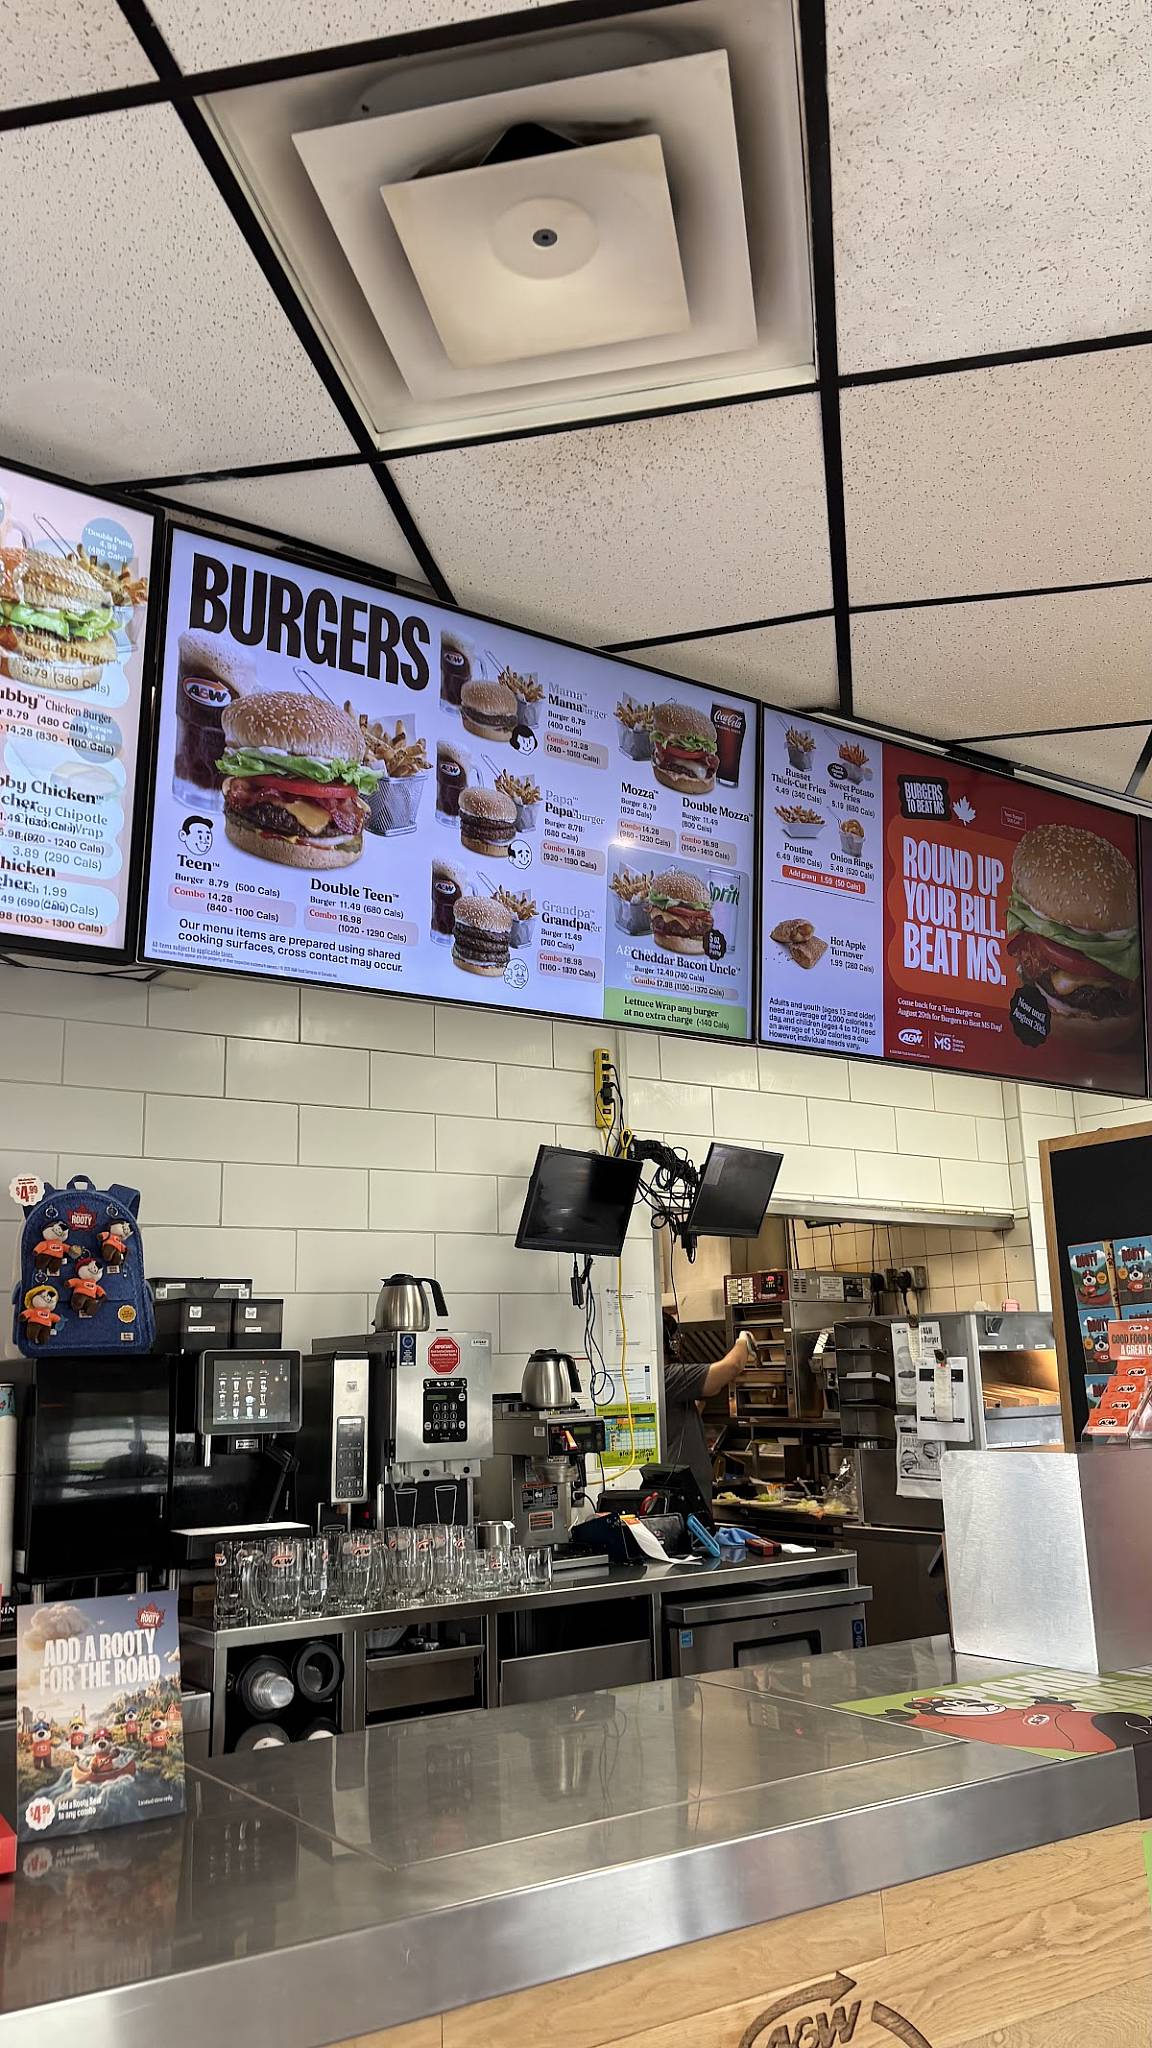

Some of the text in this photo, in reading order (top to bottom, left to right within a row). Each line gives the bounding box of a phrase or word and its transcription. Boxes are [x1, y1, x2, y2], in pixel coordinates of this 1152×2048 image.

[189, 552, 431, 692] BURGERS
[22, 665, 79, 687] 3.79 (360
[188, 685, 228, 703] A&W
[45, 699, 112, 724] Chicken Burger
[6, 708, 29, 721] 8.79
[37, 715, 59, 727] (480
[62, 721, 88, 735] Cals)
[6, 723, 33, 737] 14.28
[36, 730, 58, 743] (830
[808, 784, 827, 795] Fries
[850, 786, 875, 799] Potato
[904, 782, 943, 801] BURGERS
[682, 796, 718, 815] Double
[906, 799, 945, 815] TO BEAT MS
[54, 838, 105, 856] 1240 Cals)
[784, 842, 813, 857] Poutine
[12, 845, 102, 872] 3.89 (290 Cals)
[830, 852, 874, 870] Onion Rings
[903, 835, 1005, 897] ROUND UP
[43, 885, 67, 898] 1.99
[174, 886, 233, 904] Combo 14.28
[175, 873, 280, 899] Burger 8.79 (500 Cals)
[310, 877, 360, 898] Double
[206, 903, 279, 923] (840 1100 Cals)
[309, 908, 362, 925] Combo 16.98
[310, 895, 404, 920] Burger 11.49 (680 Cals)
[903, 880, 1006, 940] YOUR BILL.
[16, 913, 103, 935] (1030 1300 Cals)
[337, 923, 407, 943] (1020 1290 Cals)
[541, 928, 563, 939] Burger
[179, 918, 401, 962] Our menu items are prepared using shared
[830, 936, 867, 952] Hot Apple
[178, 931, 223, 948] cooking
[225, 936, 275, 955] surfaces,
[277, 946, 307, 959] cross
[309, 950, 349, 966] contact
[350, 957, 372, 970] may
[374, 960, 403, 973] occur.
[539, 952, 563, 964] Combo
[631, 947, 676, 967] Cheddar
[677, 957, 708, 972] Bacon
[830, 947, 864, 960] Turnover
[903, 922, 1007, 986] BEAT MS.
[624, 995, 719, 1019] Lettuce Wrap any burger
[769, 997, 821, 1014] Adults and youth
[769, 1006, 785, 1014] need
[897, 997, 974, 1019] Come back for Burger
[1017, 997, 1031, 1012] Now
[645, 1011, 666, 1022] extra
[667, 1014, 693, 1026] charge
[783, 1016, 795, 1024] and
[897, 1008, 918, 1019] August
[932, 1013, 941, 1021] for
[941, 1016, 962, 1026] Burgers
[1012, 1008, 1033, 1027] August
[901, 1033, 923, 1045] A&W
[934, 1036, 952, 1050] MS
[71, 1214, 93, 1226] ROOTY
[1120, 1344, 1146, 1355] A GREAT
[140, 1612, 160, 1625] ROOTY
[43, 1628, 156, 1668] ADD A ROOTY
[39, 1654, 161, 1696] FOR THE ROAD
[767, 2000, 861, 2048] A&W
